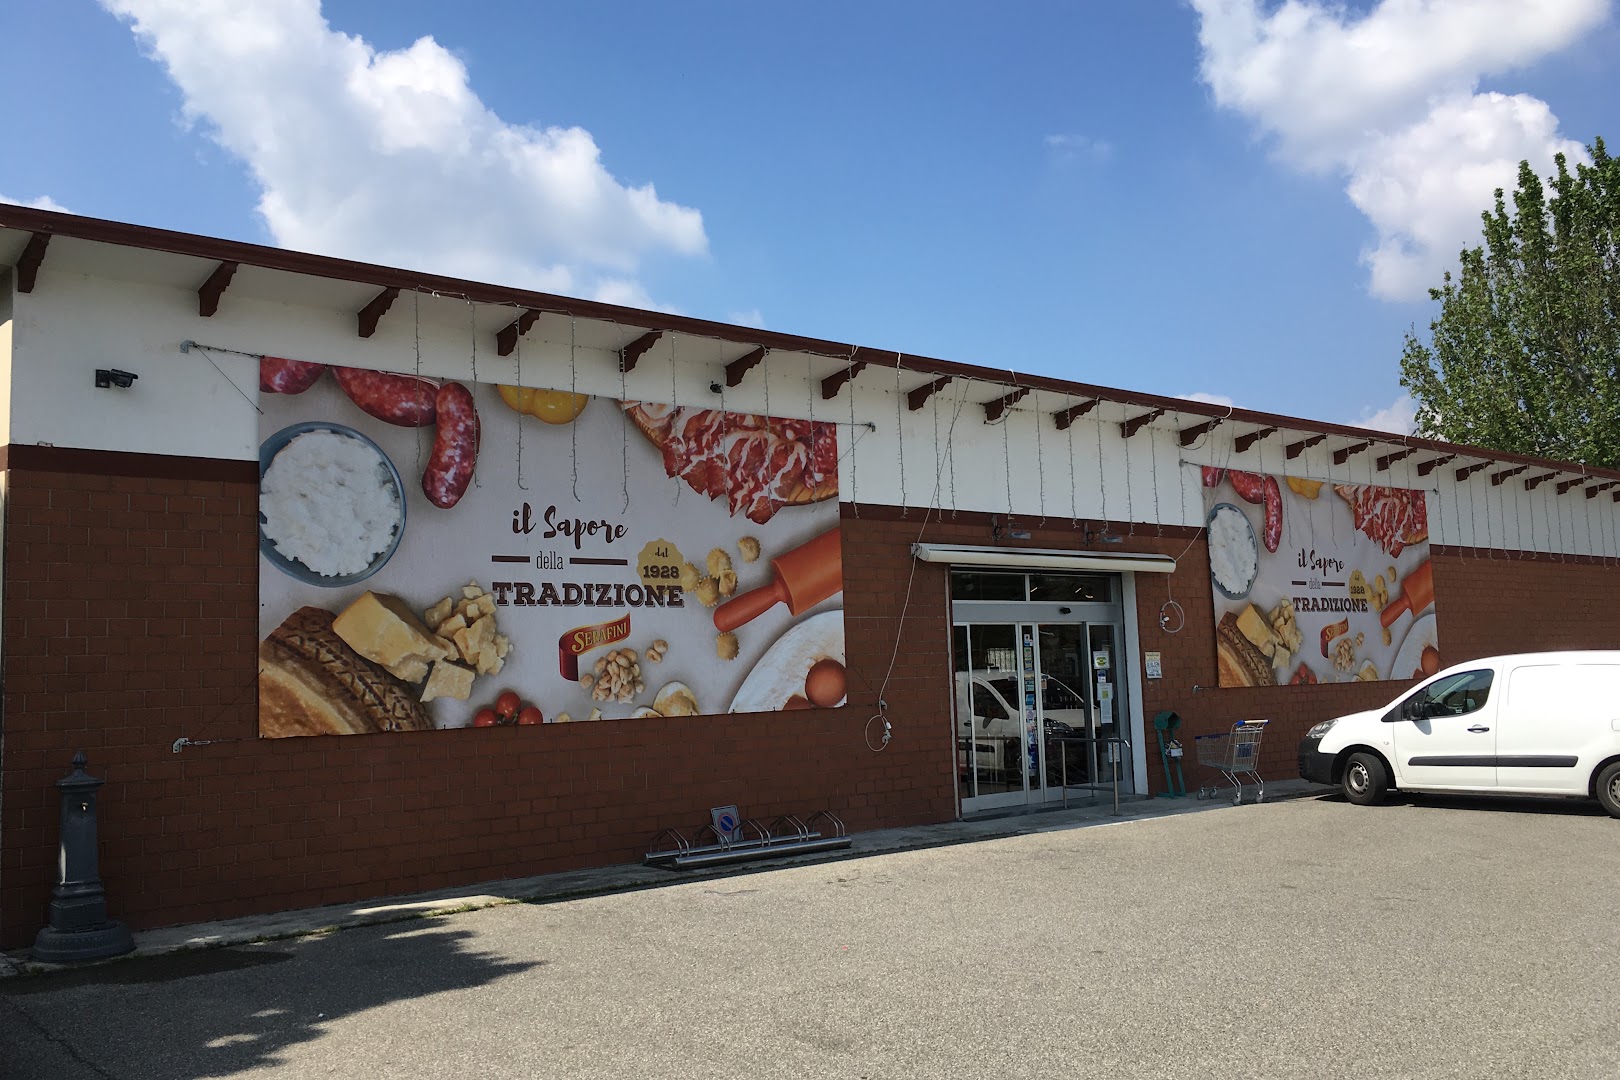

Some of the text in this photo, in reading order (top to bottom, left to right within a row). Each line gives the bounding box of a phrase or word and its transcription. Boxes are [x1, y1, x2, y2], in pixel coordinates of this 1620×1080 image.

[512, 502, 629, 550] il Sapore
[536, 550, 564, 570] della
[654, 546, 669, 558] dal
[1298, 548, 1344, 576] il Sapore
[643, 565, 680, 579] 1928
[492, 581, 685, 608] TRADIZIONE
[1292, 597, 1368, 613] TRADIZIONE
[571, 621, 628, 653] SERAFINI
